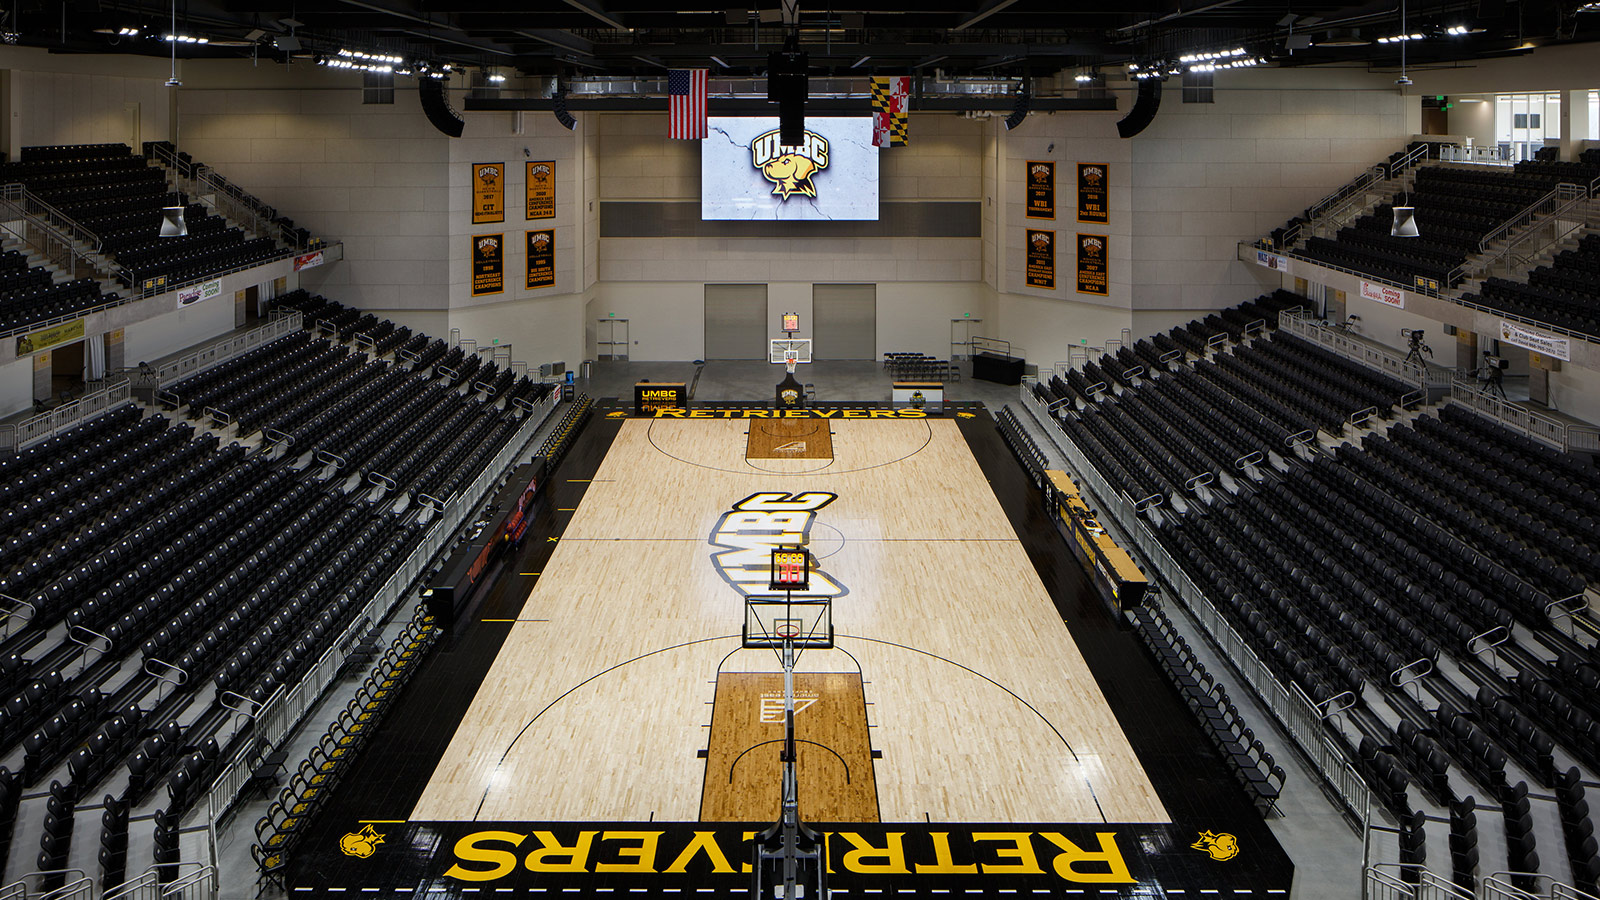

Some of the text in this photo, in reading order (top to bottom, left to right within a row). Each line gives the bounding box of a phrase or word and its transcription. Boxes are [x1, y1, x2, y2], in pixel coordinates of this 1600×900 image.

[480, 167, 498, 178] UMBC
[532, 165, 550, 175] UMBC
[1032, 165, 1050, 175] UMBC
[1083, 168, 1102, 177] UMBC
[478, 238, 498, 249] UMBC
[532, 234, 550, 244] UMBC
[1032, 234, 1049, 244] UMBC
[1083, 238, 1102, 249] UMBC
[203, 281, 219, 290] Coming
[179, 289, 202, 302] Paradise
[204, 287, 220, 297] SOON!
[1382, 288, 1400, 299] Coming
[1384, 295, 1400, 305] SOON!
[653, 408, 928, 419] RETRIEVERS
